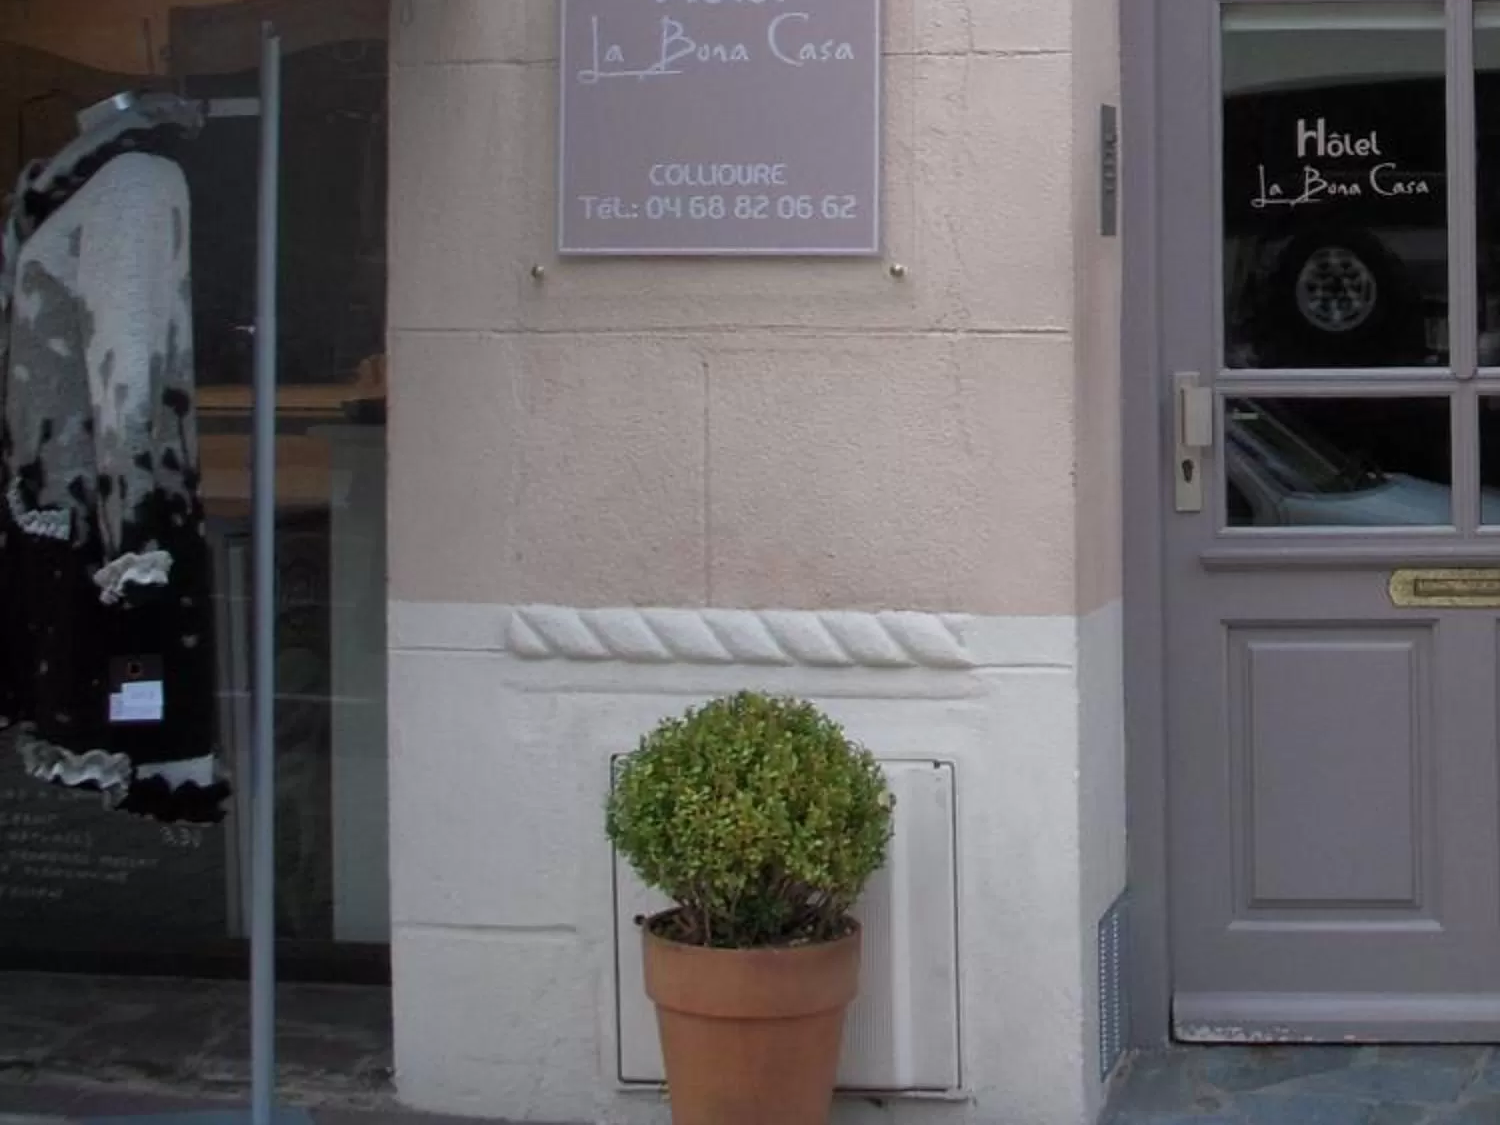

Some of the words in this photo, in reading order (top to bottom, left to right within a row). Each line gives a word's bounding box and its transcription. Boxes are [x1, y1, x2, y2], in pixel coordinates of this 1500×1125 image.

[577, 15, 628, 83] La
[640, 15, 749, 75] Bona
[767, 11, 855, 67] Casa
[1297, 117, 1382, 158] Hôtel
[649, 163, 787, 186] COLLIOURE
[1251, 163, 1292, 208] La
[1293, 164, 1361, 206] Bona
[1370, 162, 1429, 196] Casa
[645, 196, 681, 219] 04
[689, 196, 724, 219] 68
[734, 196, 769, 219] 82
[776, 196, 812, 219] 06
[820, 196, 857, 219] 62
